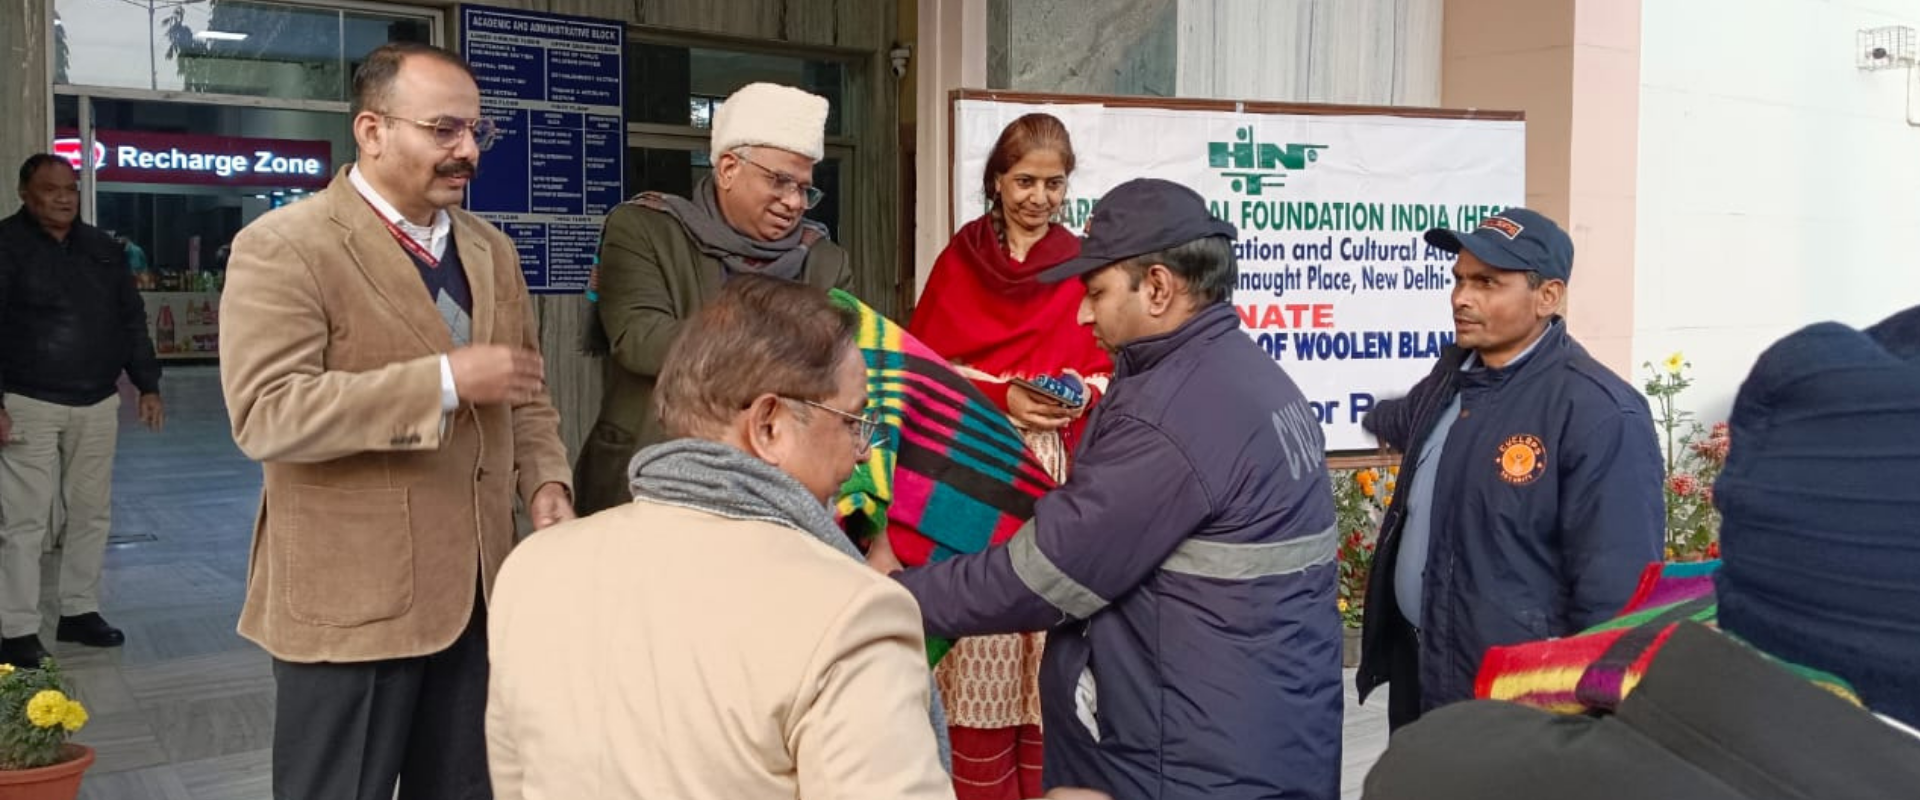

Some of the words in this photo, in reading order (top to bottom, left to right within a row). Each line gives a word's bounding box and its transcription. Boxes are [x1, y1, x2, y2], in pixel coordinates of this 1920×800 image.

[472, 15, 511, 30] ACADEMIC
[513, 20, 528, 32] AND
[530, 22, 590, 38] ADMINISTRATIVE
[591, 29, 616, 40] BLOCK
[117, 146, 247, 176] Recharge
[254, 151, 320, 174] Zone
[1242, 201, 1384, 232] FOUNDATION
[1391, 203, 1450, 232] INDIA
[1232, 236, 1285, 260] ation
[1292, 237, 1333, 261] and
[1340, 238, 1417, 261] Cultural
[1307, 265, 1357, 294] Place,
[1362, 266, 1398, 290] New
[1235, 304, 1334, 329] NATE
[1257, 332, 1288, 361] OF
[1293, 332, 1392, 360] WOOLEN
[1398, 331, 1454, 358] BLAN
[1309, 400, 1339, 424] or
[1349, 393, 1375, 423] P
